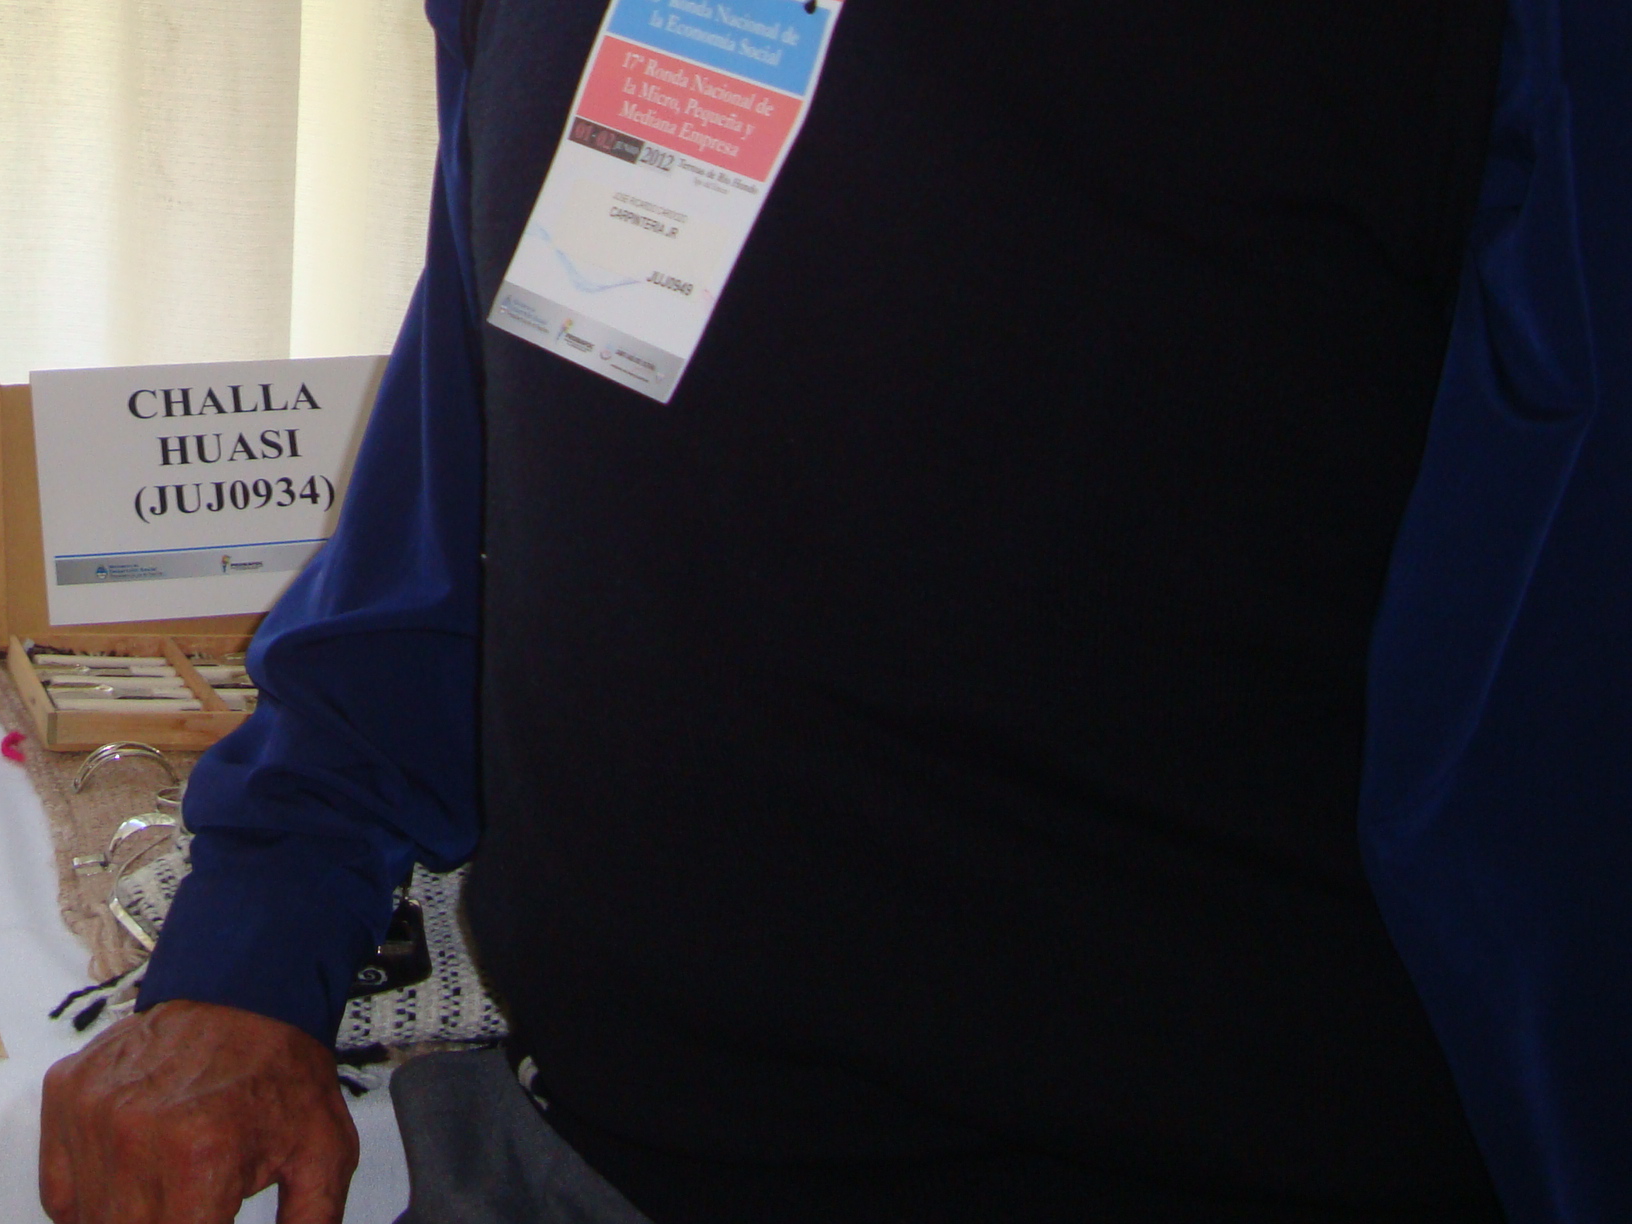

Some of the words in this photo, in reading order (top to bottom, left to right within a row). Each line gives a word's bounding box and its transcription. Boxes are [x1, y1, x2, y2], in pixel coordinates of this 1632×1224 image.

[715, 4, 780, 40] Nacional
[622, 77, 637, 95] la
[638, 81, 681, 114] Micro,
[684, 97, 741, 132] Pequeña
[740, 125, 756, 140] y
[644, 59, 689, 88] Ronda
[690, 74, 756, 110] Nacional
[755, 97, 774, 116] de
[618, 100, 677, 134] Mediana
[677, 122, 740, 157] Empresa
[639, 146, 675, 171] 2012
[127, 383, 322, 420] CHALLA
[156, 428, 304, 466] HUASI
[134, 474, 336, 524] (JUJ0934)
